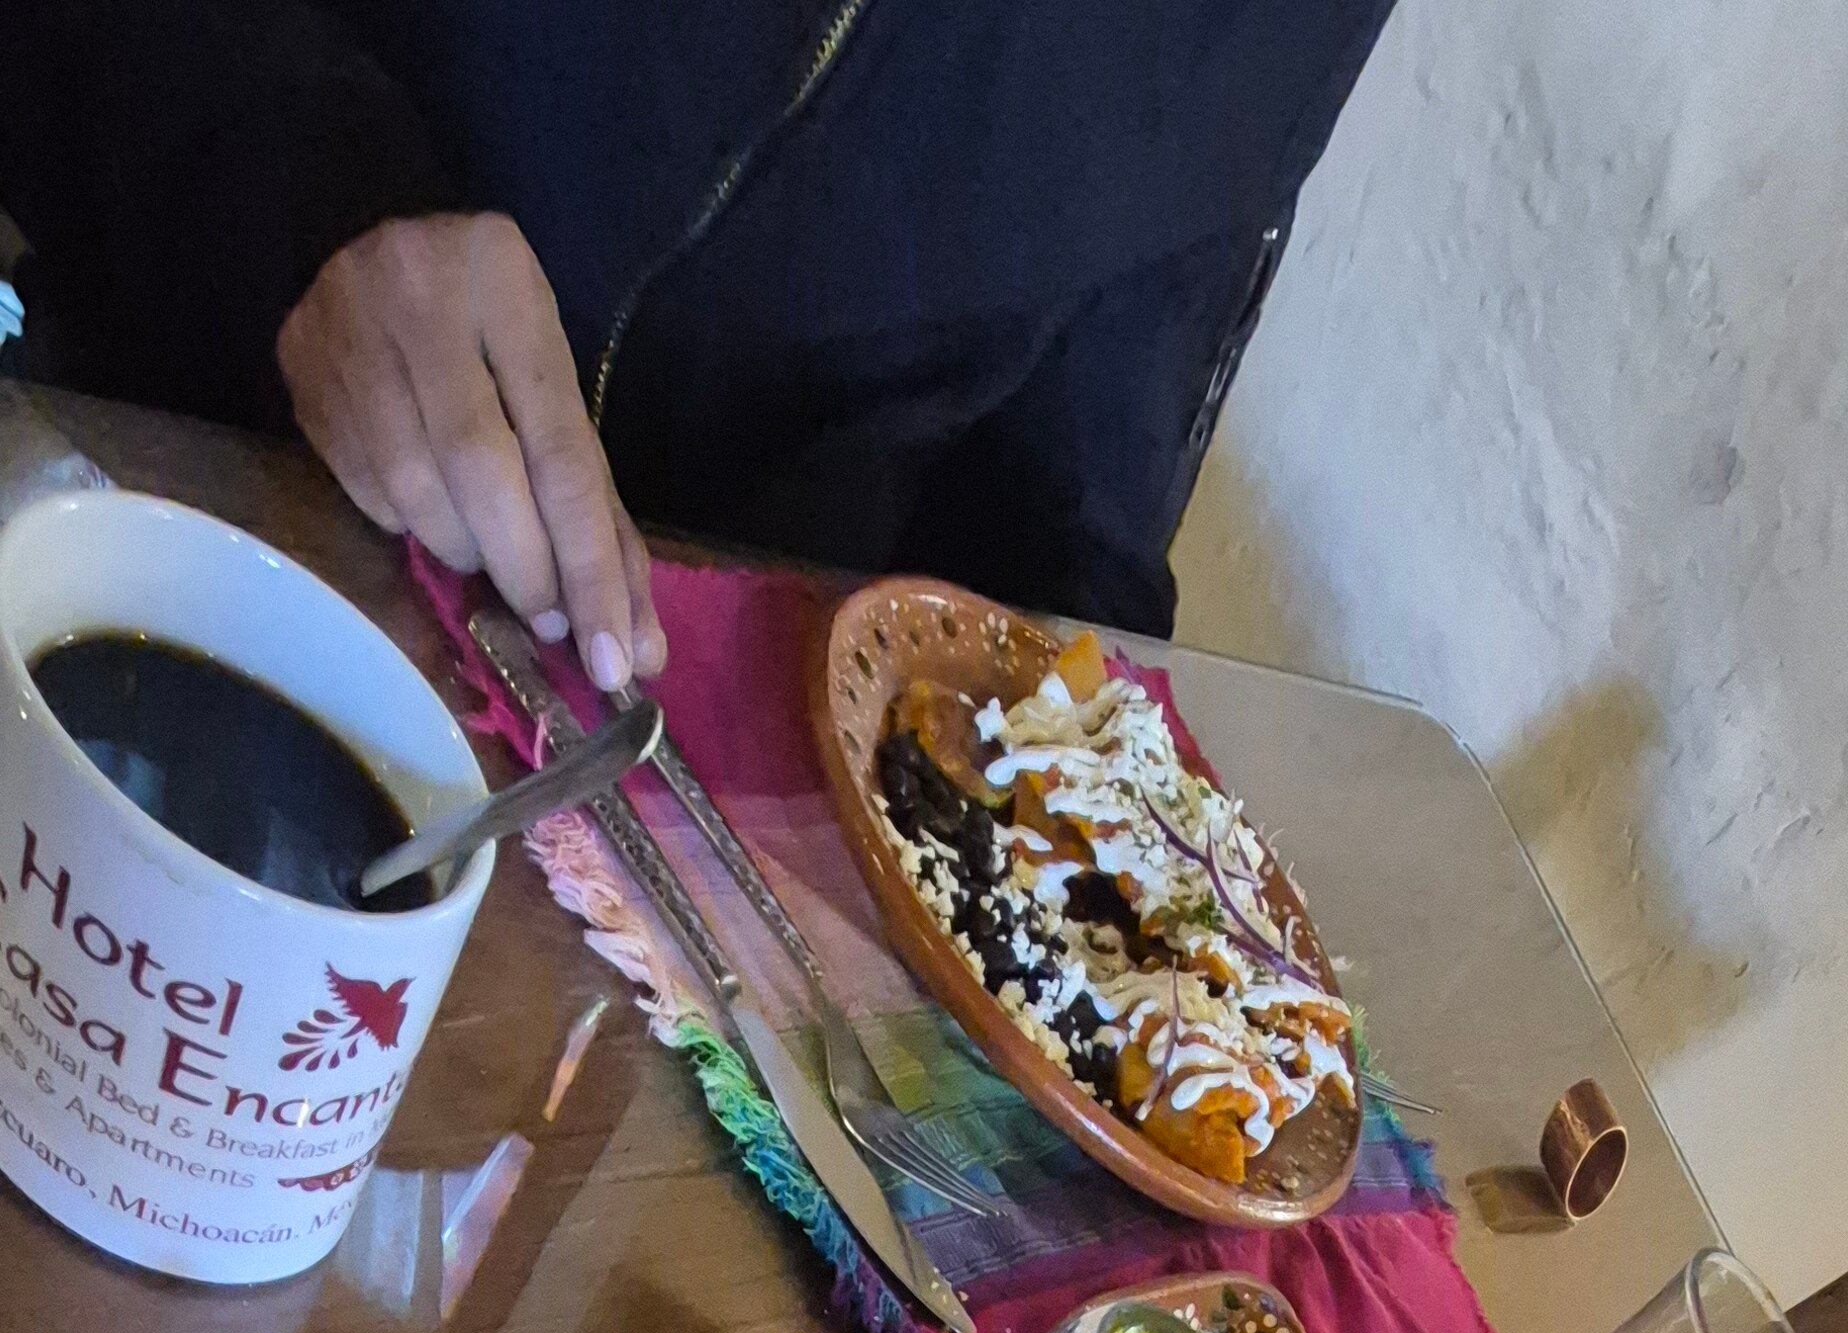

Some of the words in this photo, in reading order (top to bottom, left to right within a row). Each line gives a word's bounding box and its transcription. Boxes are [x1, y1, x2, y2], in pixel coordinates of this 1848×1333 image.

[20, 820, 244, 1037] Hotel
[0, 942, 126, 1067] asa
[0, 1100, 96, 1199] cuaro,
[36, 1067, 56, 1094] &
[65, 1096, 256, 1188] Apartments
[98, 1074, 159, 1126] Bed
[170, 1116, 194, 1139] &
[206, 1127, 338, 1159] Breakfast
